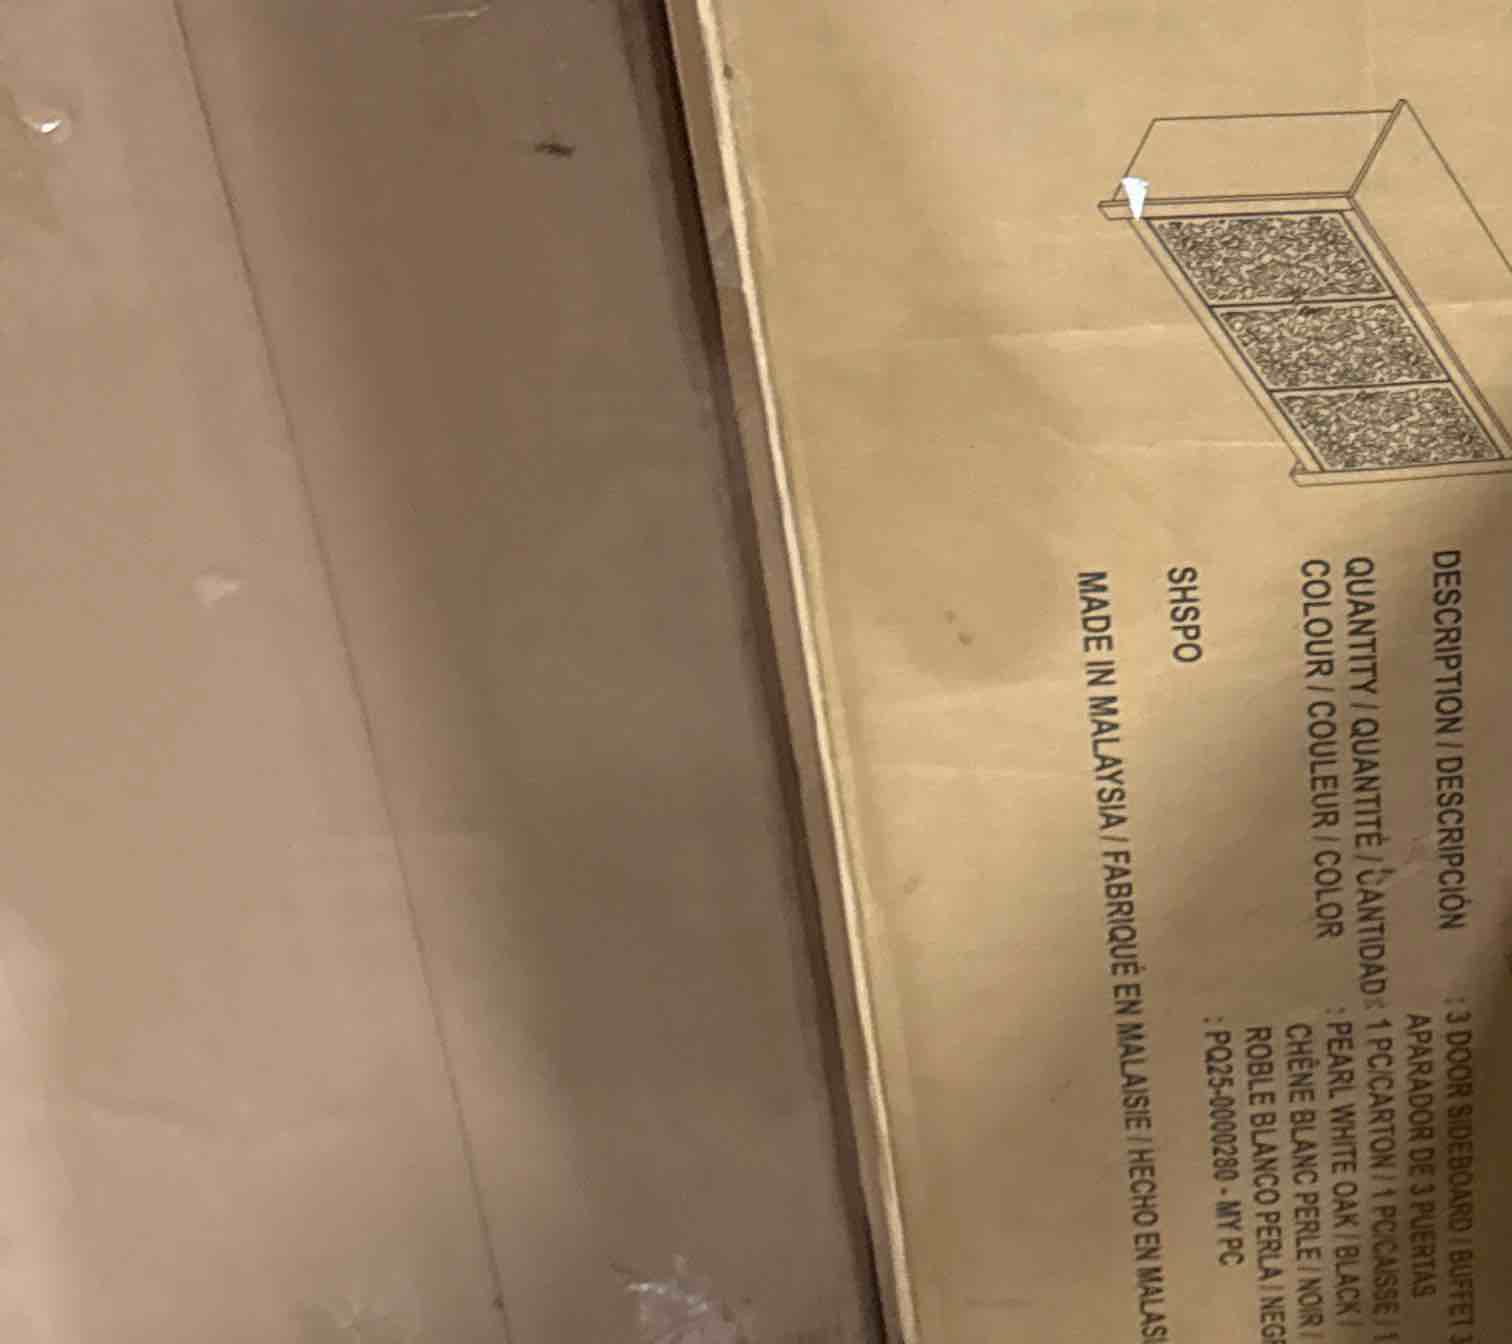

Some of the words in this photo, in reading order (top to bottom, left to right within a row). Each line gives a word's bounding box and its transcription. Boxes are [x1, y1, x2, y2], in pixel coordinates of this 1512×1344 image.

[1077, 571, 1114, 652] MADE
[1166, 566, 1203, 663] SHSPO
[1300, 559, 1334, 678] COLOUR
[1344, 556, 1378, 694] QUANTITY
[1432, 550, 1464, 734] DESCRIPTION
[1084, 660, 1117, 686] IN
[1088, 696, 1128, 830] MALAYSIA
[1306, 700, 1340, 829] COULEUR
[1349, 717, 1390, 848] QUANTITÉ
[1436, 756, 1472, 930] DESCRIPCIÓN
[1101, 850, 1146, 976] FABRIQUÉ
[1313, 850, 1344, 939] COLOR
[1112, 983, 1142, 1016] EN
[1366, 1018, 1392, 1030] 1
[1446, 1012, 1472, 1024] 3
[1116, 1022, 1152, 1130] MALAISIE
[1245, 1026, 1276, 1106] ROBLE
[1285, 1023, 1320, 1103] CHÊNE
[1326, 1021, 1355, 1099] PEARL
[1407, 1014, 1434, 1142] APARADOR
[1446, 1030, 1474, 1098] DOOR
[1204, 1030, 1240, 1182] PQ25-0000280
[1329, 1104, 1357, 1174] WHITE
[1250, 1112, 1280, 1206] BLANCO
[1290, 1109, 1318, 1184] BLANC
[1408, 1148, 1435, 1176] DE
[1448, 1104, 1474, 1232] SIDEBOARD
[1128, 1148, 1159, 1227] HECHO
[1216, 1200, 1242, 1231] MY
[1332, 1181, 1359, 1228] OAK
[1372, 1188, 1396, 1198] 1
[1410, 1184, 1436, 1196] 3
[1134, 1232, 1162, 1261] EN
[1218, 1237, 1245, 1266] PC
[1256, 1211, 1284, 1282] PERLA
[1294, 1192, 1322, 1261] PERLE
[1410, 1200, 1436, 1299] PUERTAS
[1298, 1278, 1324, 1327] NOIR
[1334, 1246, 1360, 1316] BLACK
[1448, 1250, 1475, 1326] BUFFET
[1374, 1332, 1398, 1341] 1
[1448, 1334, 1473, 1344] 3
